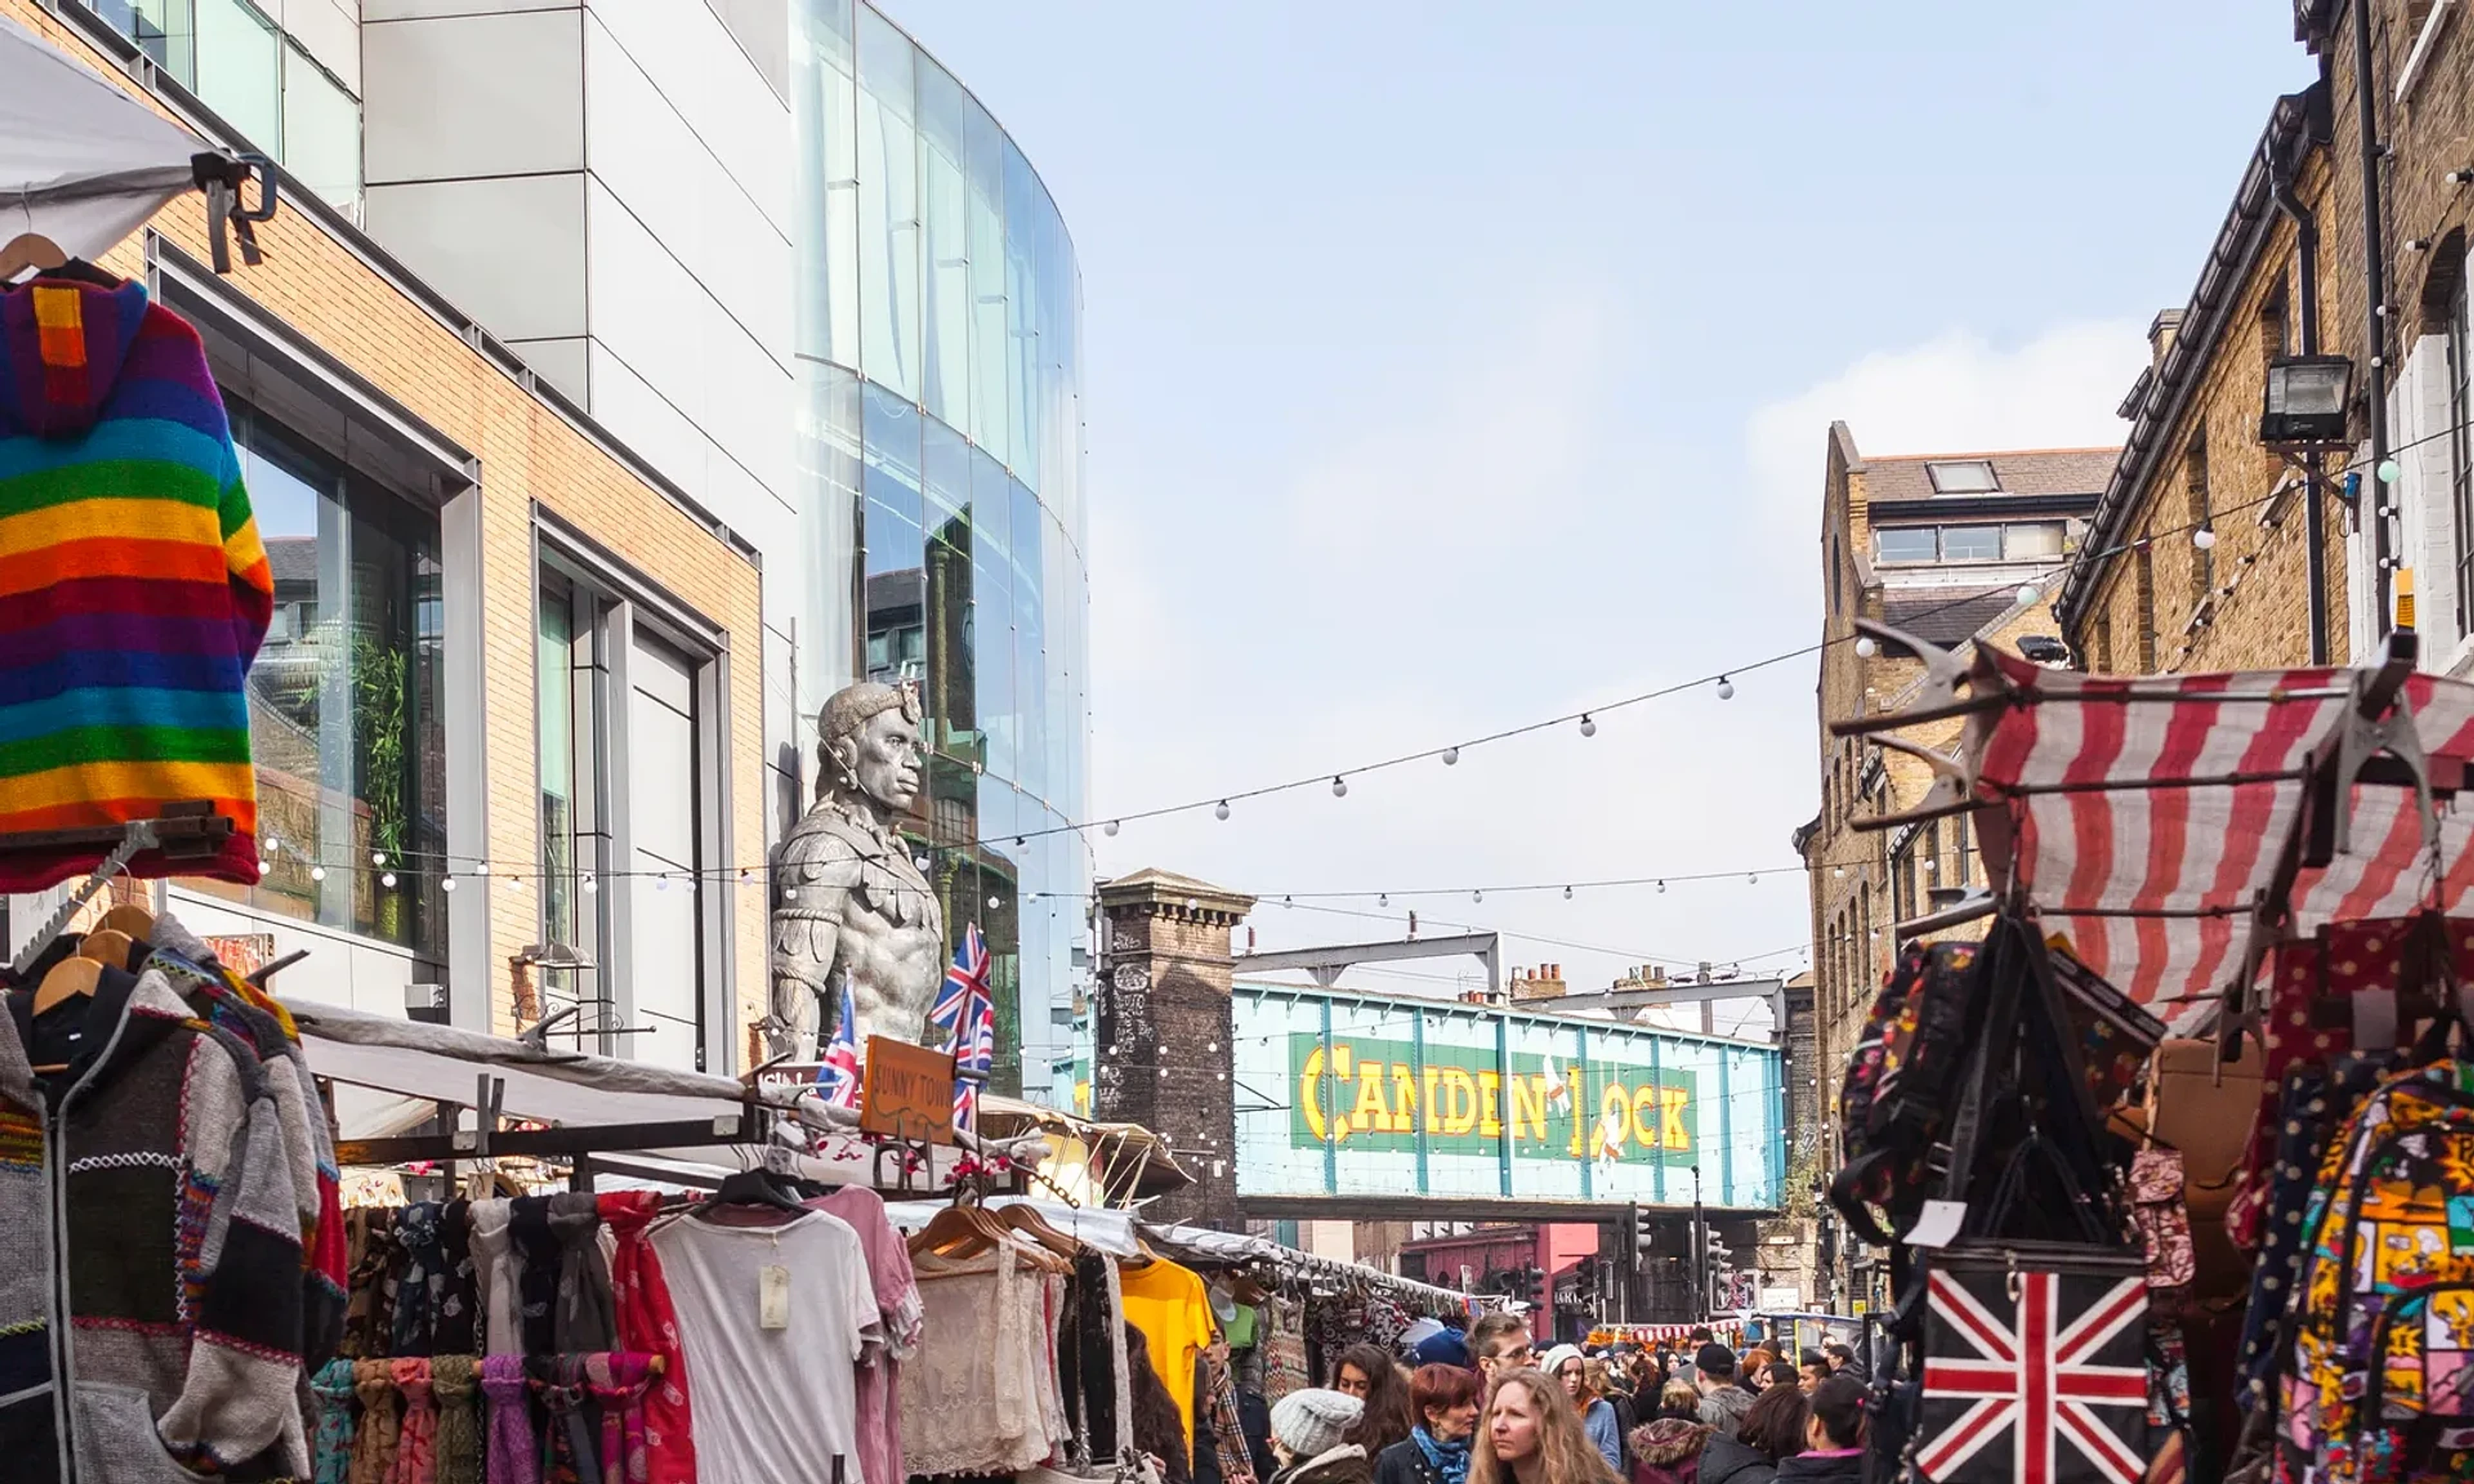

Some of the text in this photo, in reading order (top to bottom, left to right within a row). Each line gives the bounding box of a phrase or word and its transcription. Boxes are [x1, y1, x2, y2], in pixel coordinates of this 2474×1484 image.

[874, 1064, 919, 1101] SUNNY
[1301, 1044, 1689, 1157] CAMDEN LOCK
